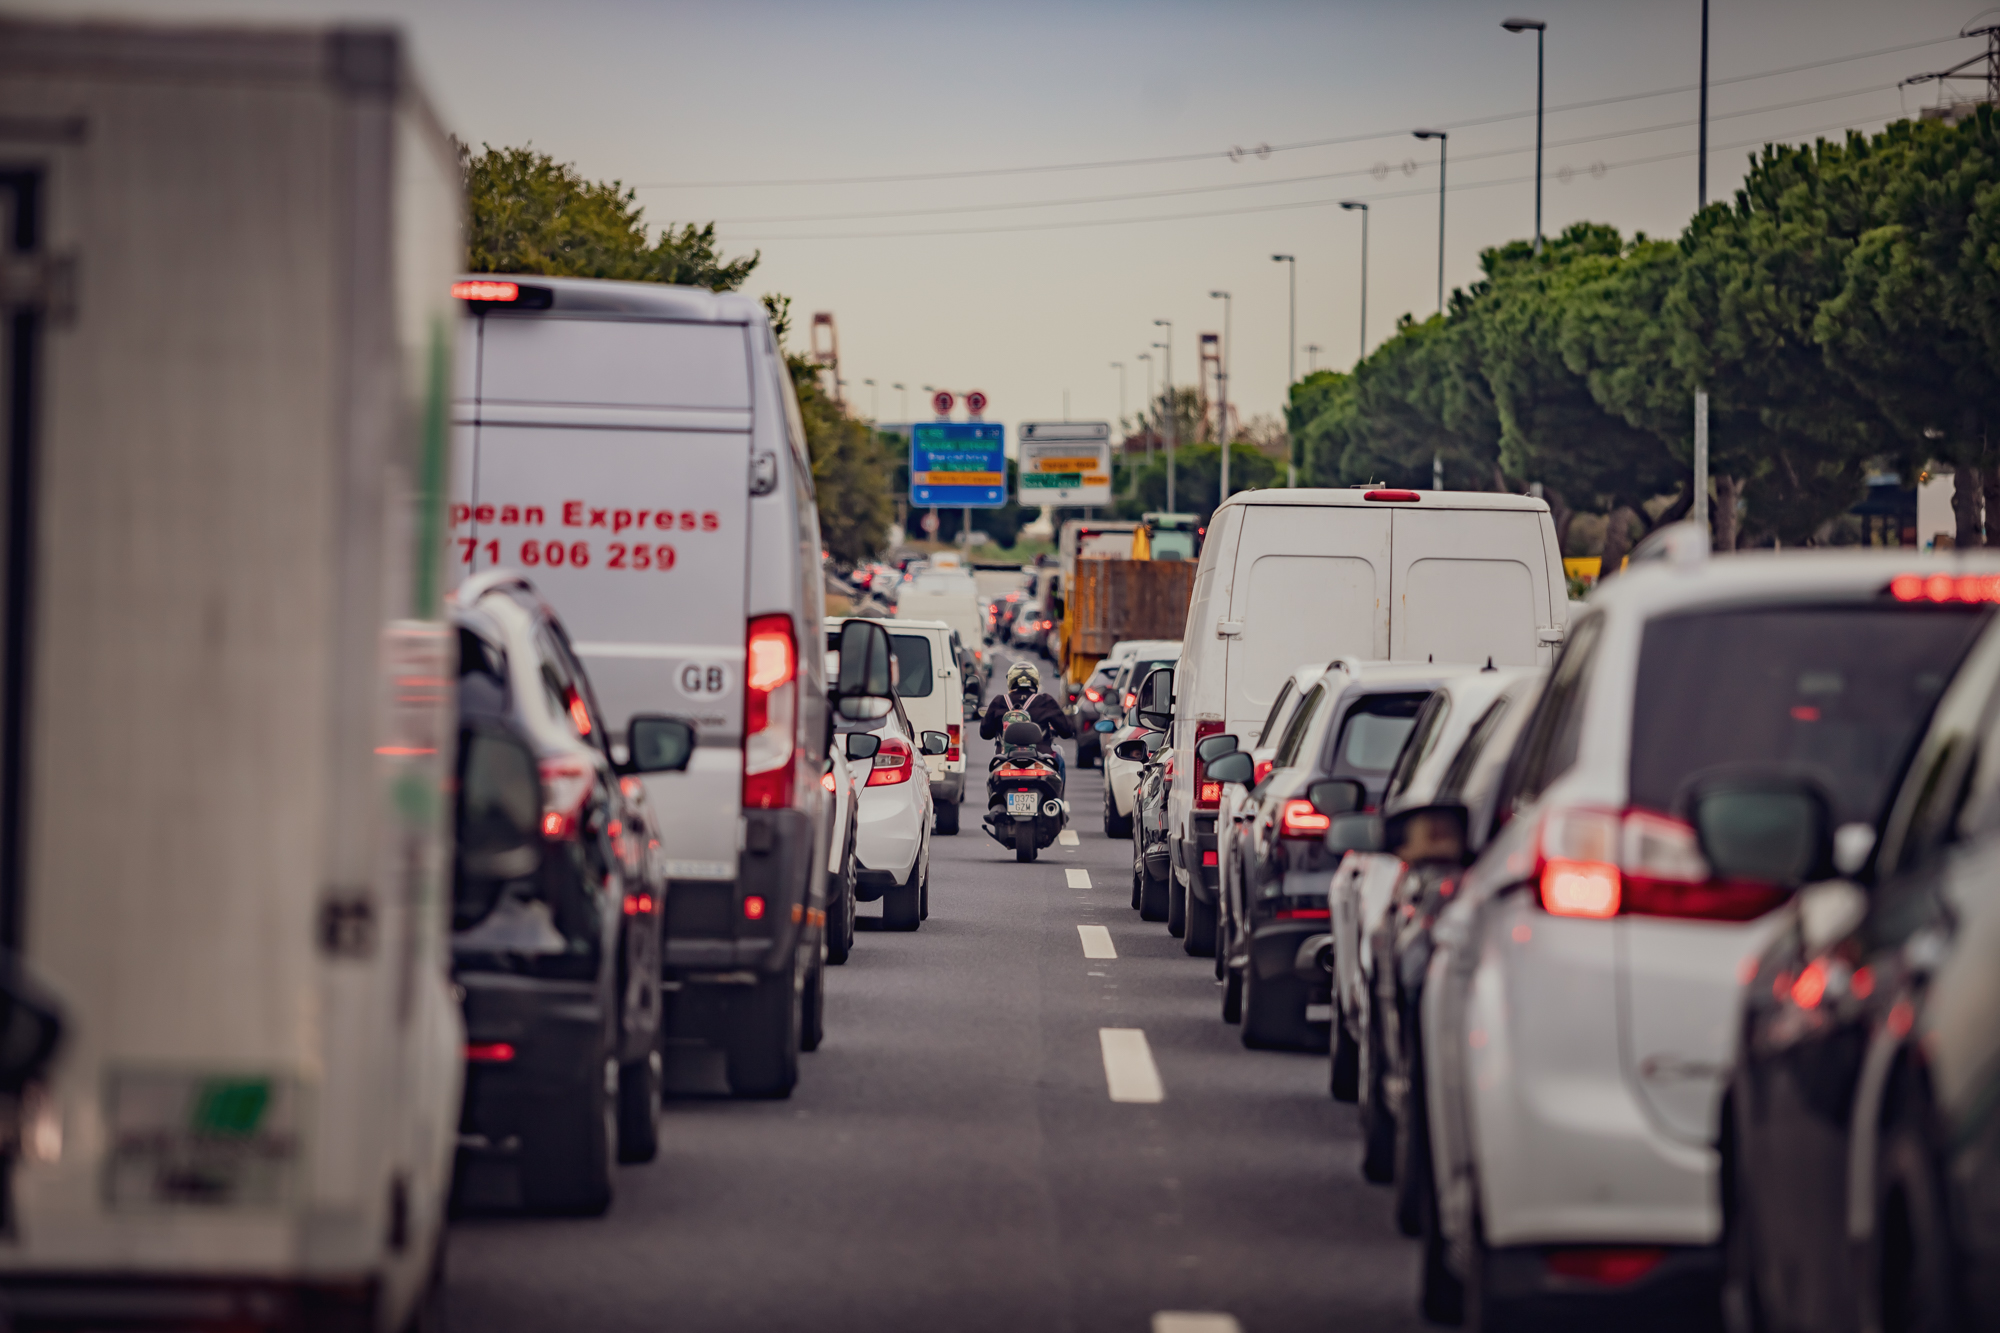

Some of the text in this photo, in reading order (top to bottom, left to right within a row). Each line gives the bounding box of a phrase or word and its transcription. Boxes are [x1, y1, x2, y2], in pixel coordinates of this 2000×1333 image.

[561, 500, 719, 535] Express
[449, 538, 676, 570] 71 606 259
[681, 664, 723, 693] GB
[1015, 794, 1035, 802] 0375
